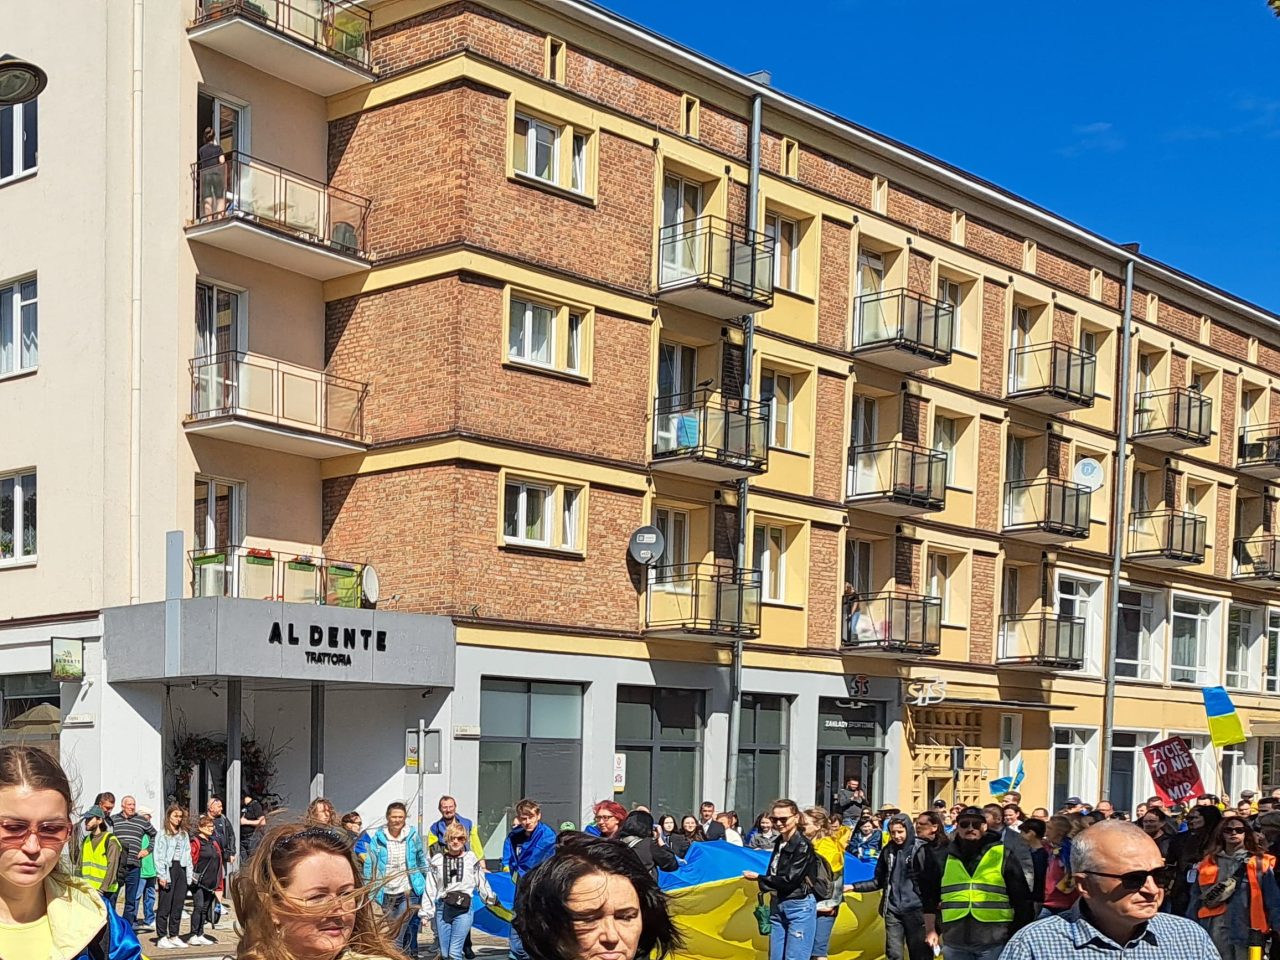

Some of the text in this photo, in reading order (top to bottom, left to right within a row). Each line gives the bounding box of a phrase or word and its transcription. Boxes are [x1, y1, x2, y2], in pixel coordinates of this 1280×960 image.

[268, 621, 387, 652] AL DENTE
[304, 651, 353, 667] TRATTORIA
[907, 677, 948, 706] STS
[1151, 752, 1193, 777] TO NIE
[1167, 781, 1196, 801] MIR
